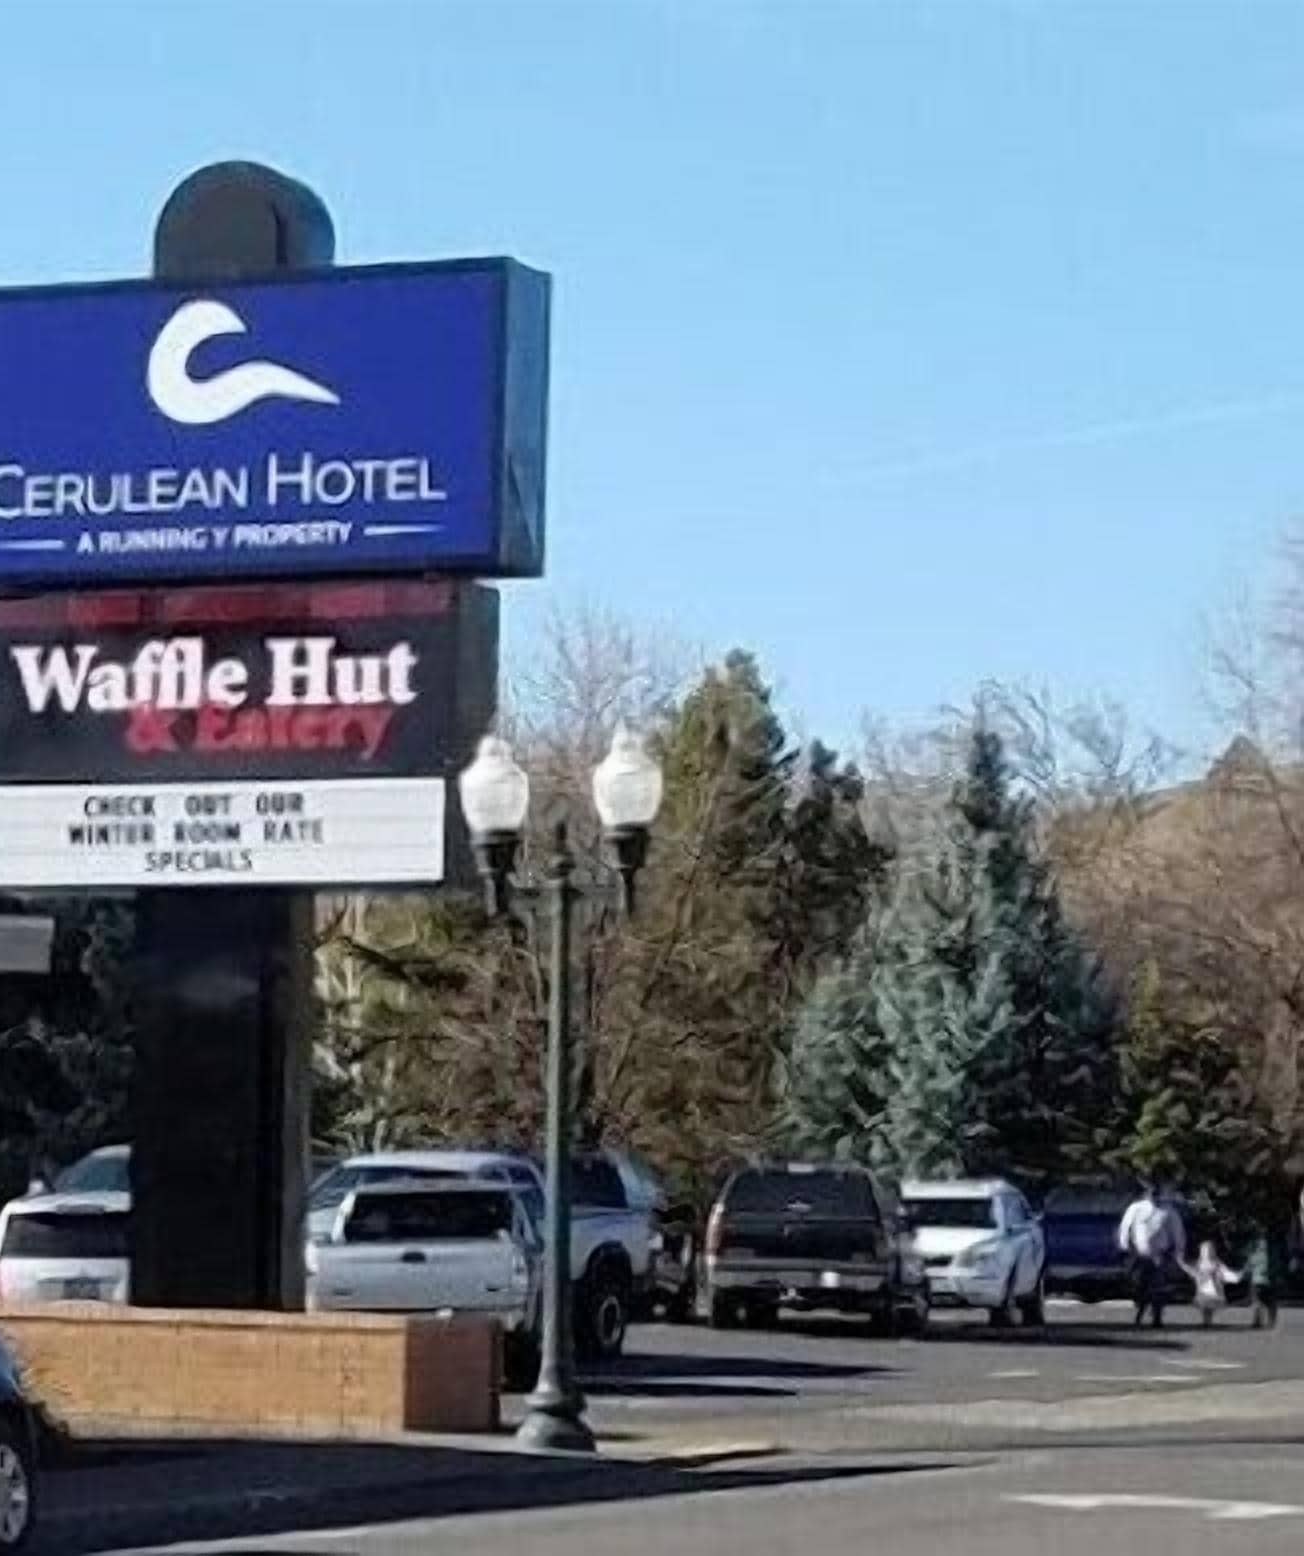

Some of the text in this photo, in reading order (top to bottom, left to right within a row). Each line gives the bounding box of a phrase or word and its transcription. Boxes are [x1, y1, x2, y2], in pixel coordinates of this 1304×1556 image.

[267, 451, 447, 505] HOTEL
[77, 520, 353, 553] A RUNNING Y PROPERTY
[11, 635, 419, 714] Waffle Hut
[194, 702, 393, 761] Eatery
[84, 791, 304, 817] CHECK OUT OUR
[68, 818, 324, 846] WINTER ROOM RATE
[144, 850, 252, 872] SPECIALS
